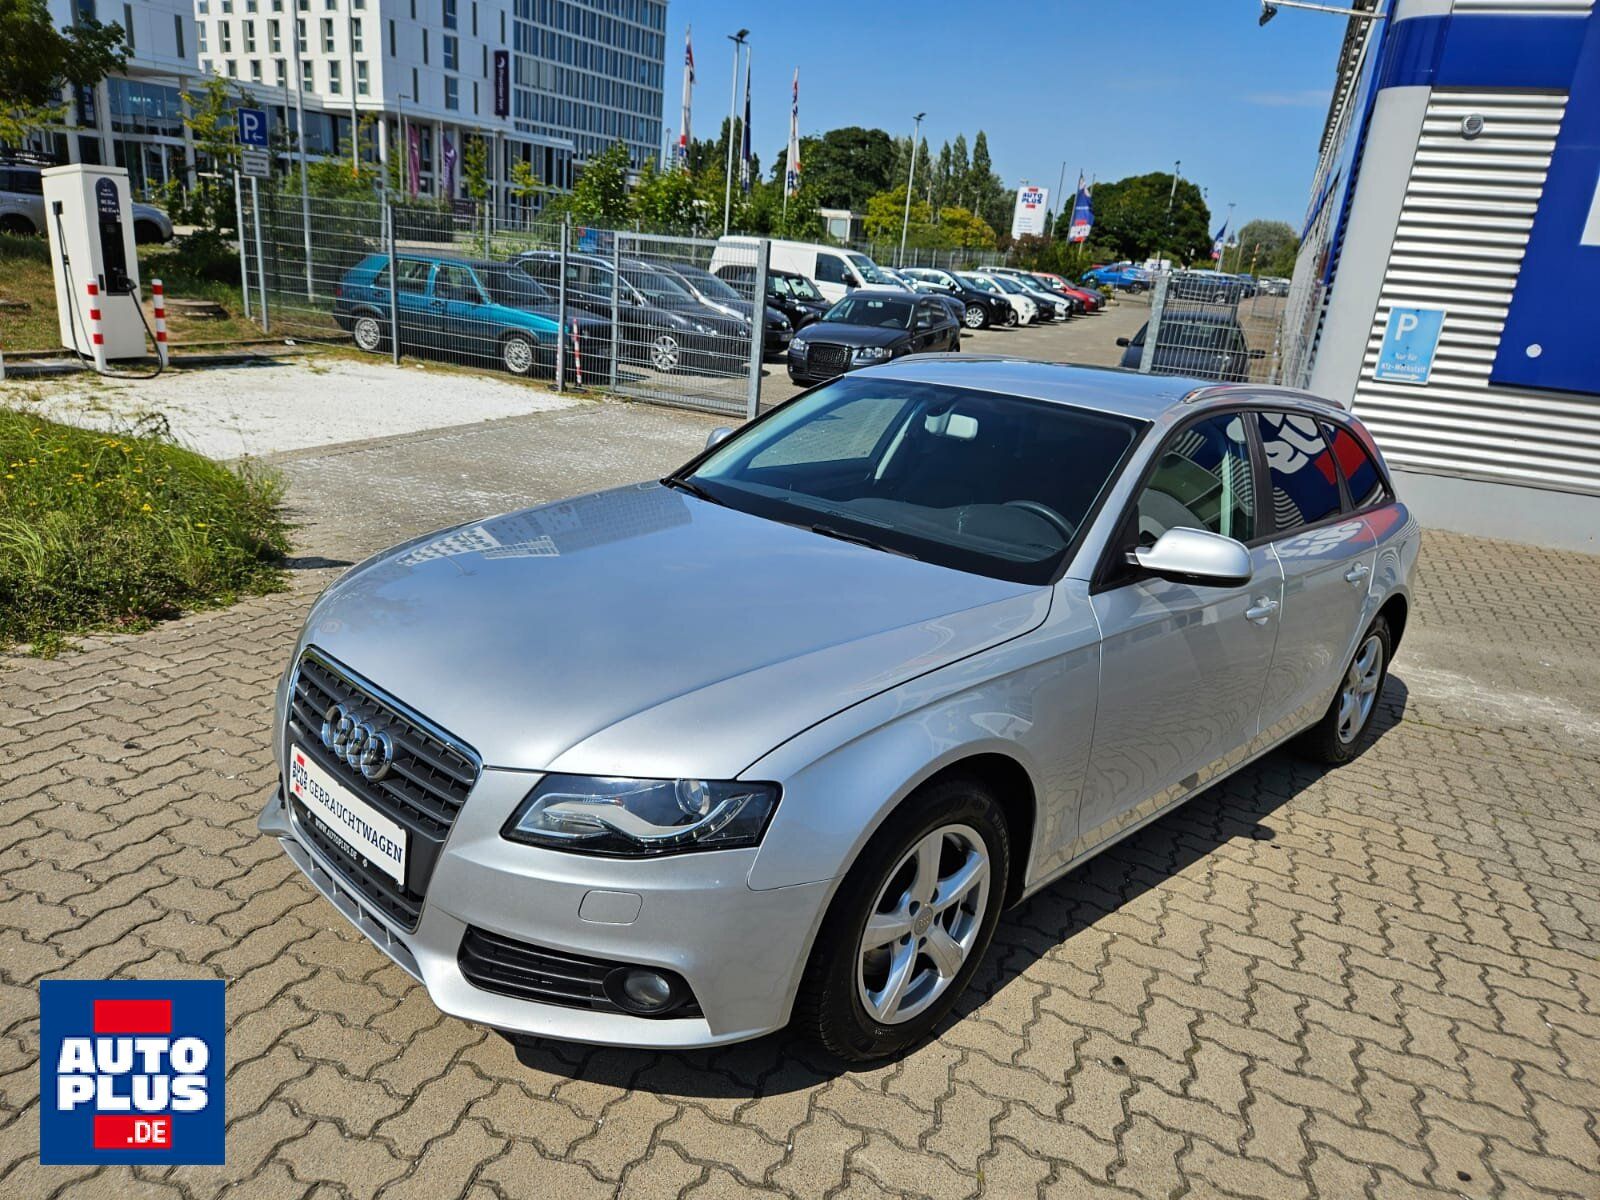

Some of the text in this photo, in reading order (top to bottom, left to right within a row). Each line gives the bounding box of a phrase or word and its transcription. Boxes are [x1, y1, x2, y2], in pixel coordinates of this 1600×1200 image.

[243, 113, 259, 140] P
[1395, 313, 1418, 340] P
[292, 760, 308, 781] AUTO
[309, 779, 402, 864] GEBRAUCHTWAGEN
